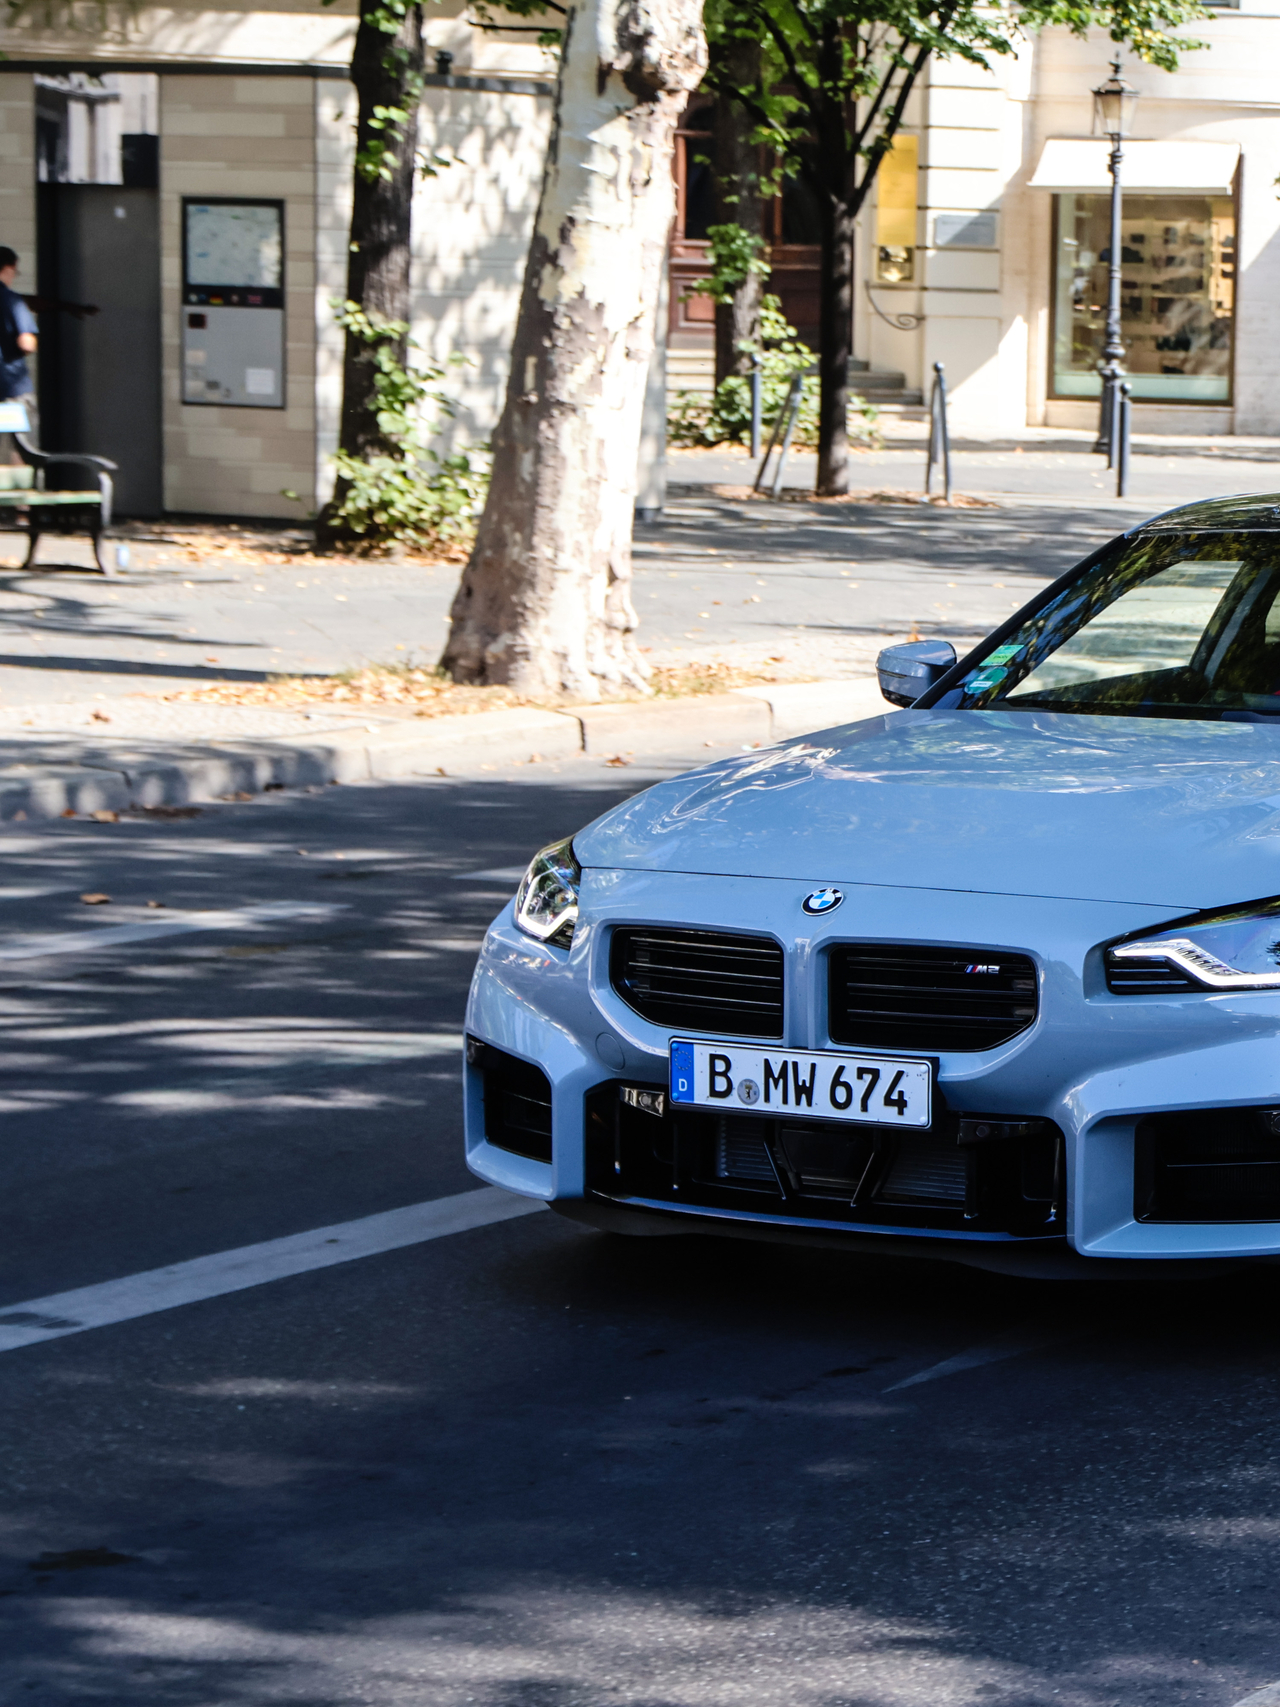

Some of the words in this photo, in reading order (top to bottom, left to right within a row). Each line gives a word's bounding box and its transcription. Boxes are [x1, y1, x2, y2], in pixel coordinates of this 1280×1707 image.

[974, 964, 1000, 974] M2
[678, 1078, 688, 1092] D
[708, 1053, 734, 1099] B
[763, 1058, 816, 1107] MW
[829, 1064, 908, 1117] 674
